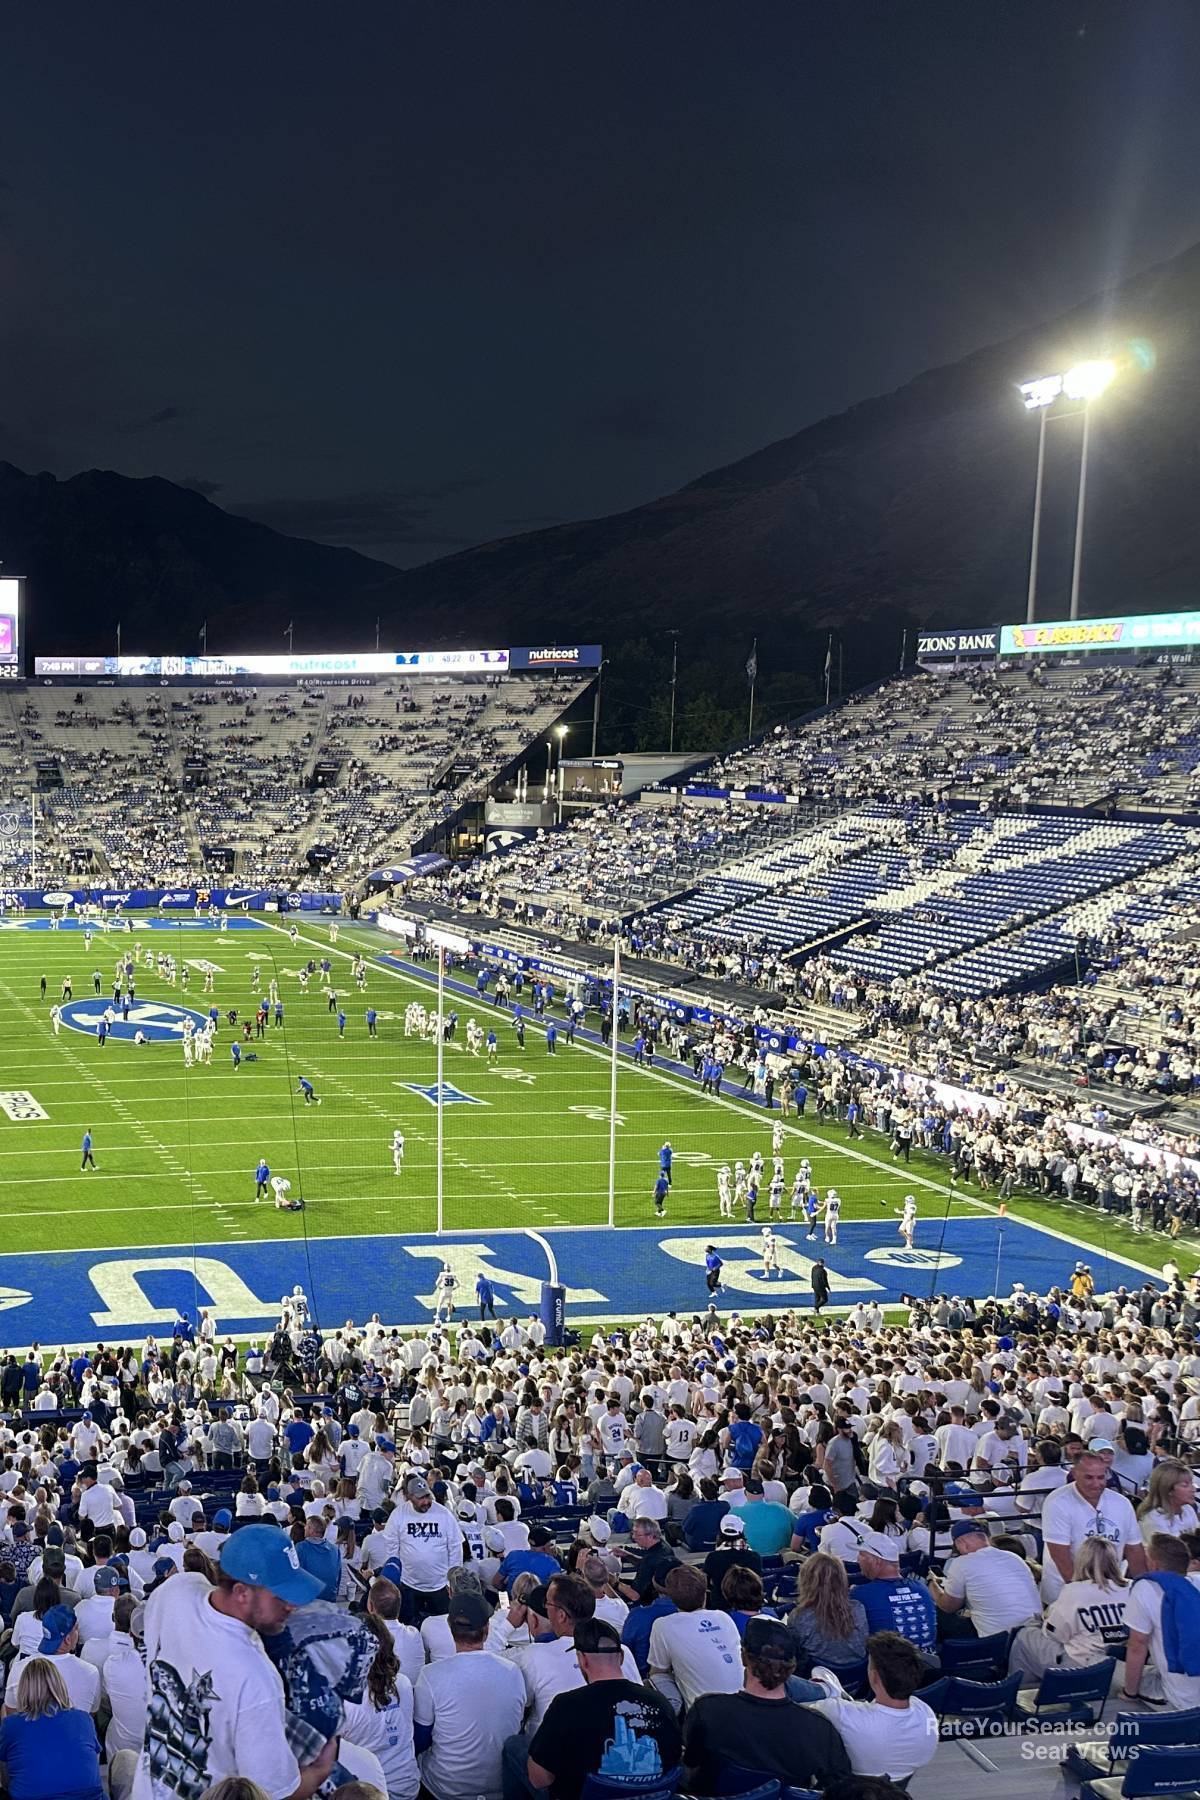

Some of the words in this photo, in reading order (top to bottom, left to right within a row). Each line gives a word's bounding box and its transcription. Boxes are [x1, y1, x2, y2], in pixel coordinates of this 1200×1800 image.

[918, 636, 956, 652] ZIONS
[959, 634, 995, 650] BANK
[529, 648, 578, 660] nutricost
[1157, 654, 1169, 663] 42
[290, 659, 357, 670] nutricost
[678, 1430, 690, 1443] 13
[566, 1490, 575, 1506] 1
[407, 1522, 439, 1535] BYU
